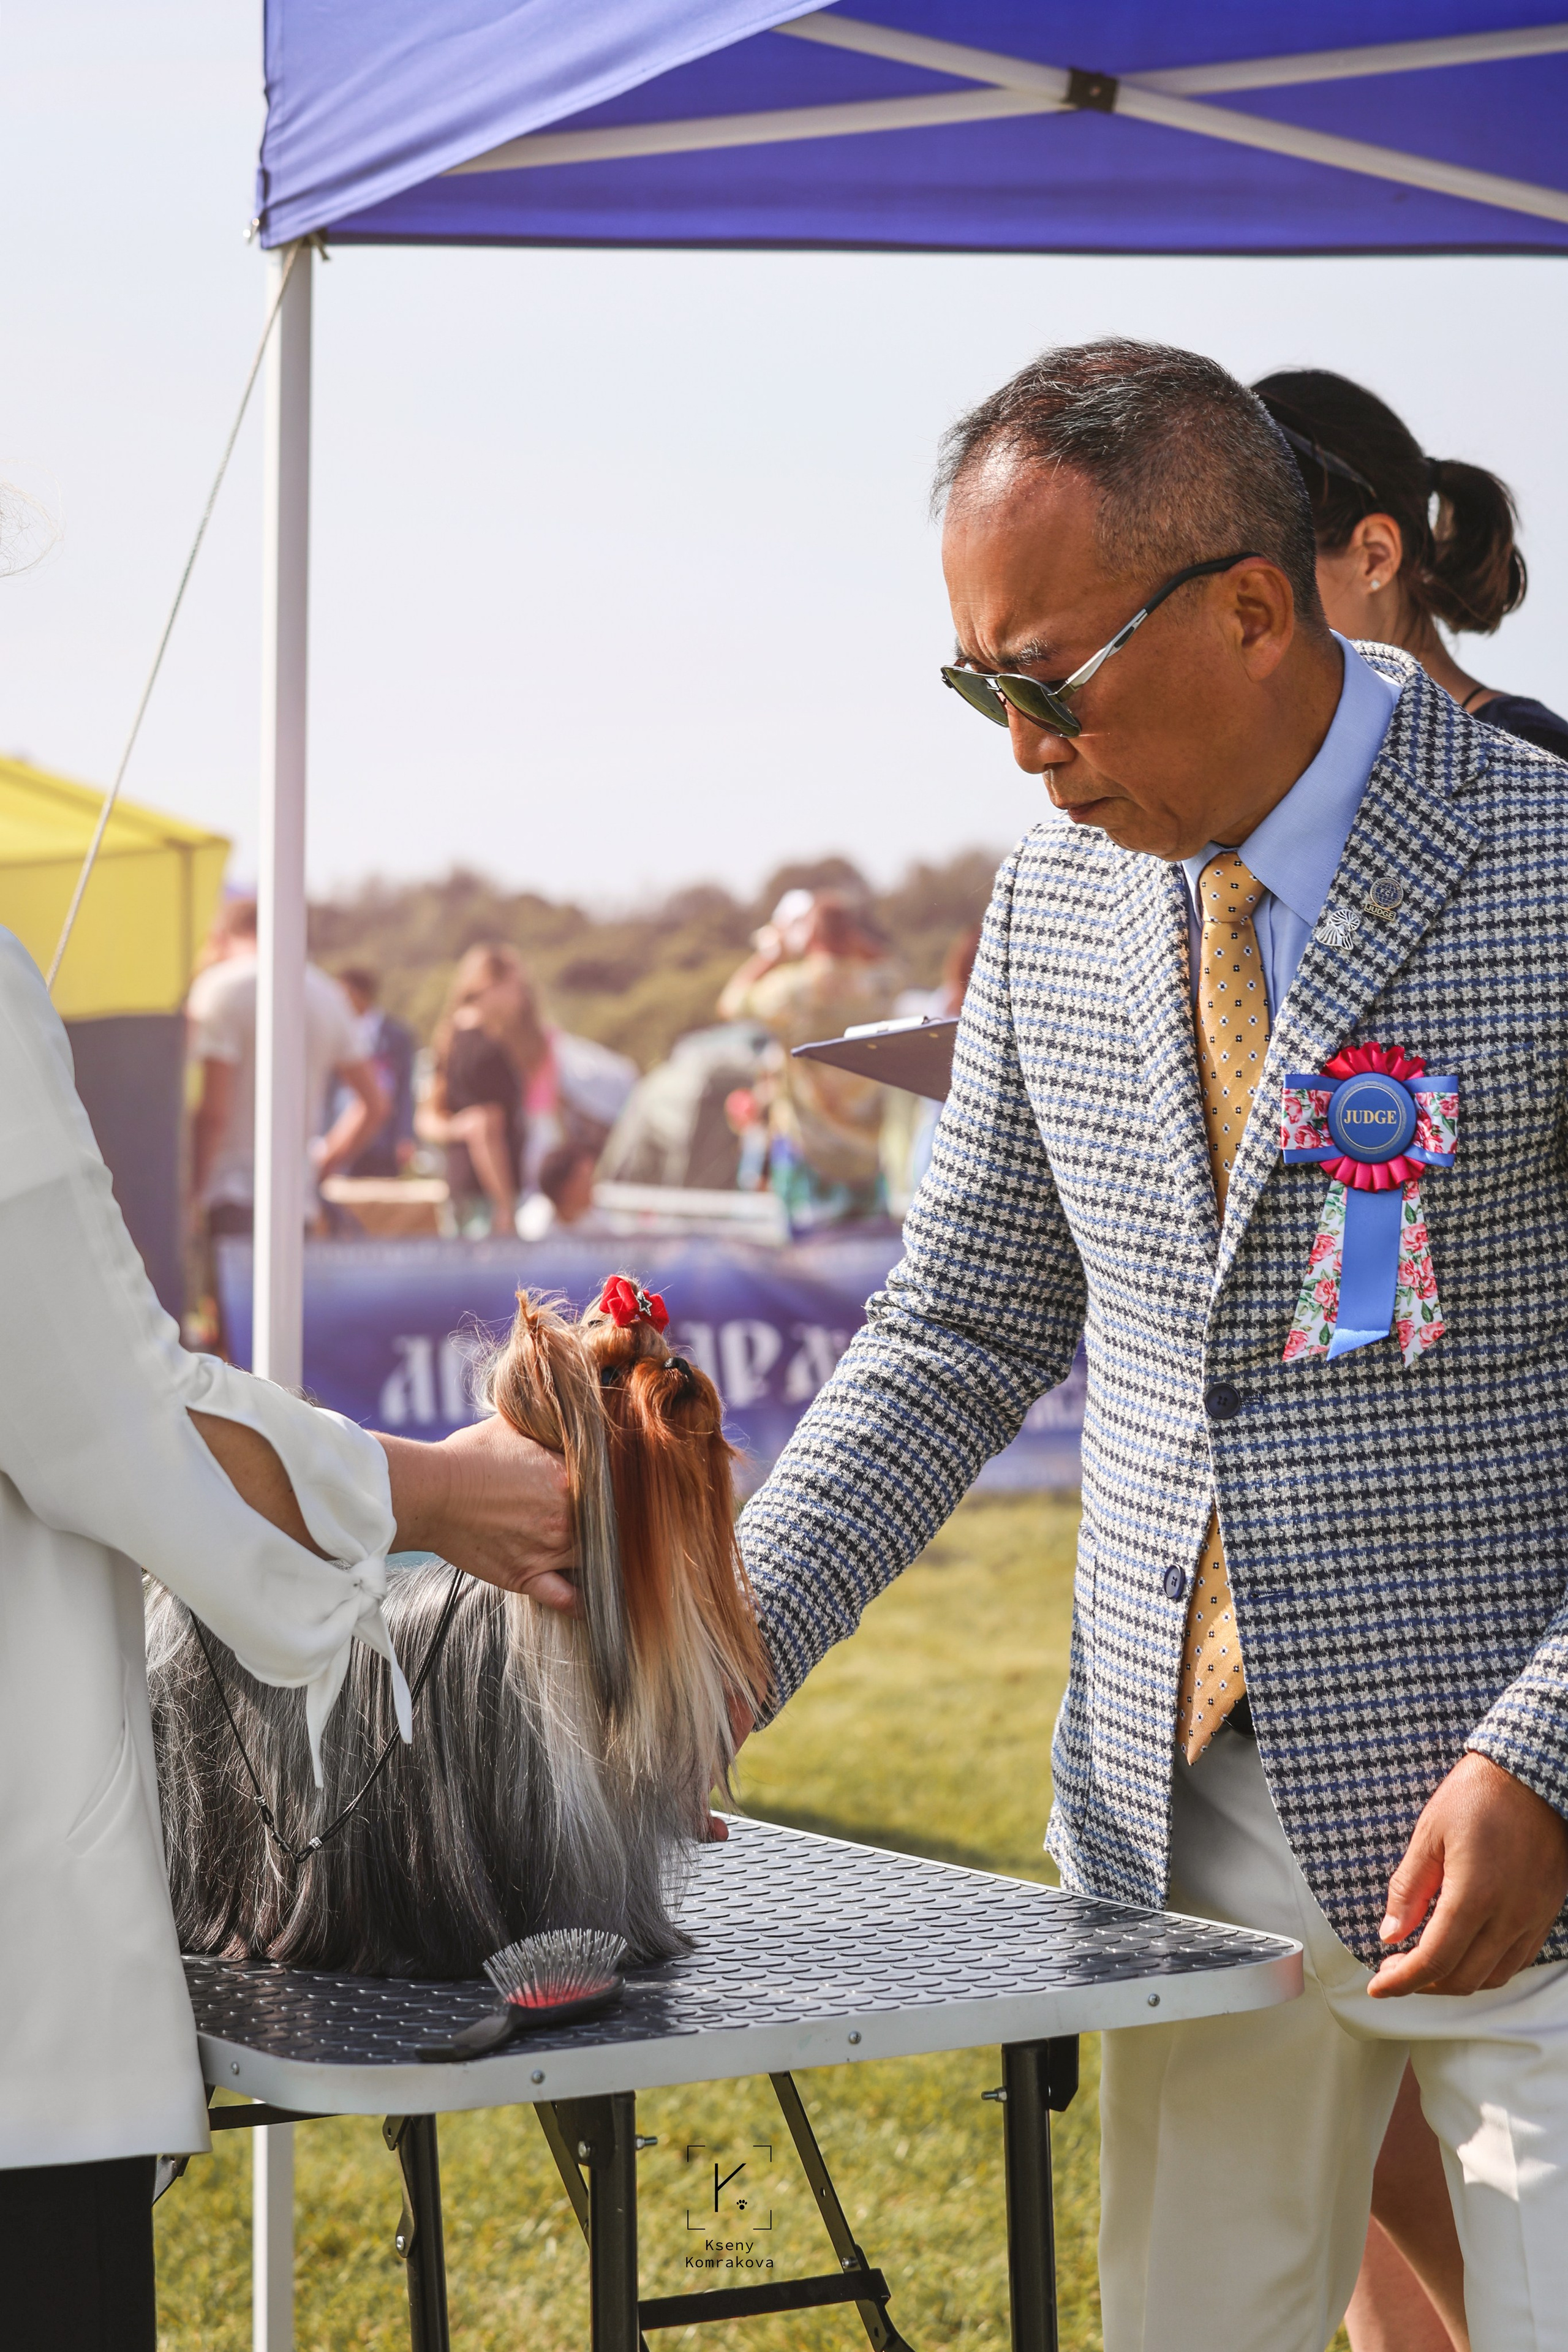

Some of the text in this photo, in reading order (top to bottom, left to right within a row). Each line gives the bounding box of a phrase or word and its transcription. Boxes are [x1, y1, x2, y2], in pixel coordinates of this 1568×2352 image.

[1380, 889, 1394, 897] FCI
[1365, 905, 1395, 919] JUDGE
[1344, 1110, 1396, 1124] JUDGE
